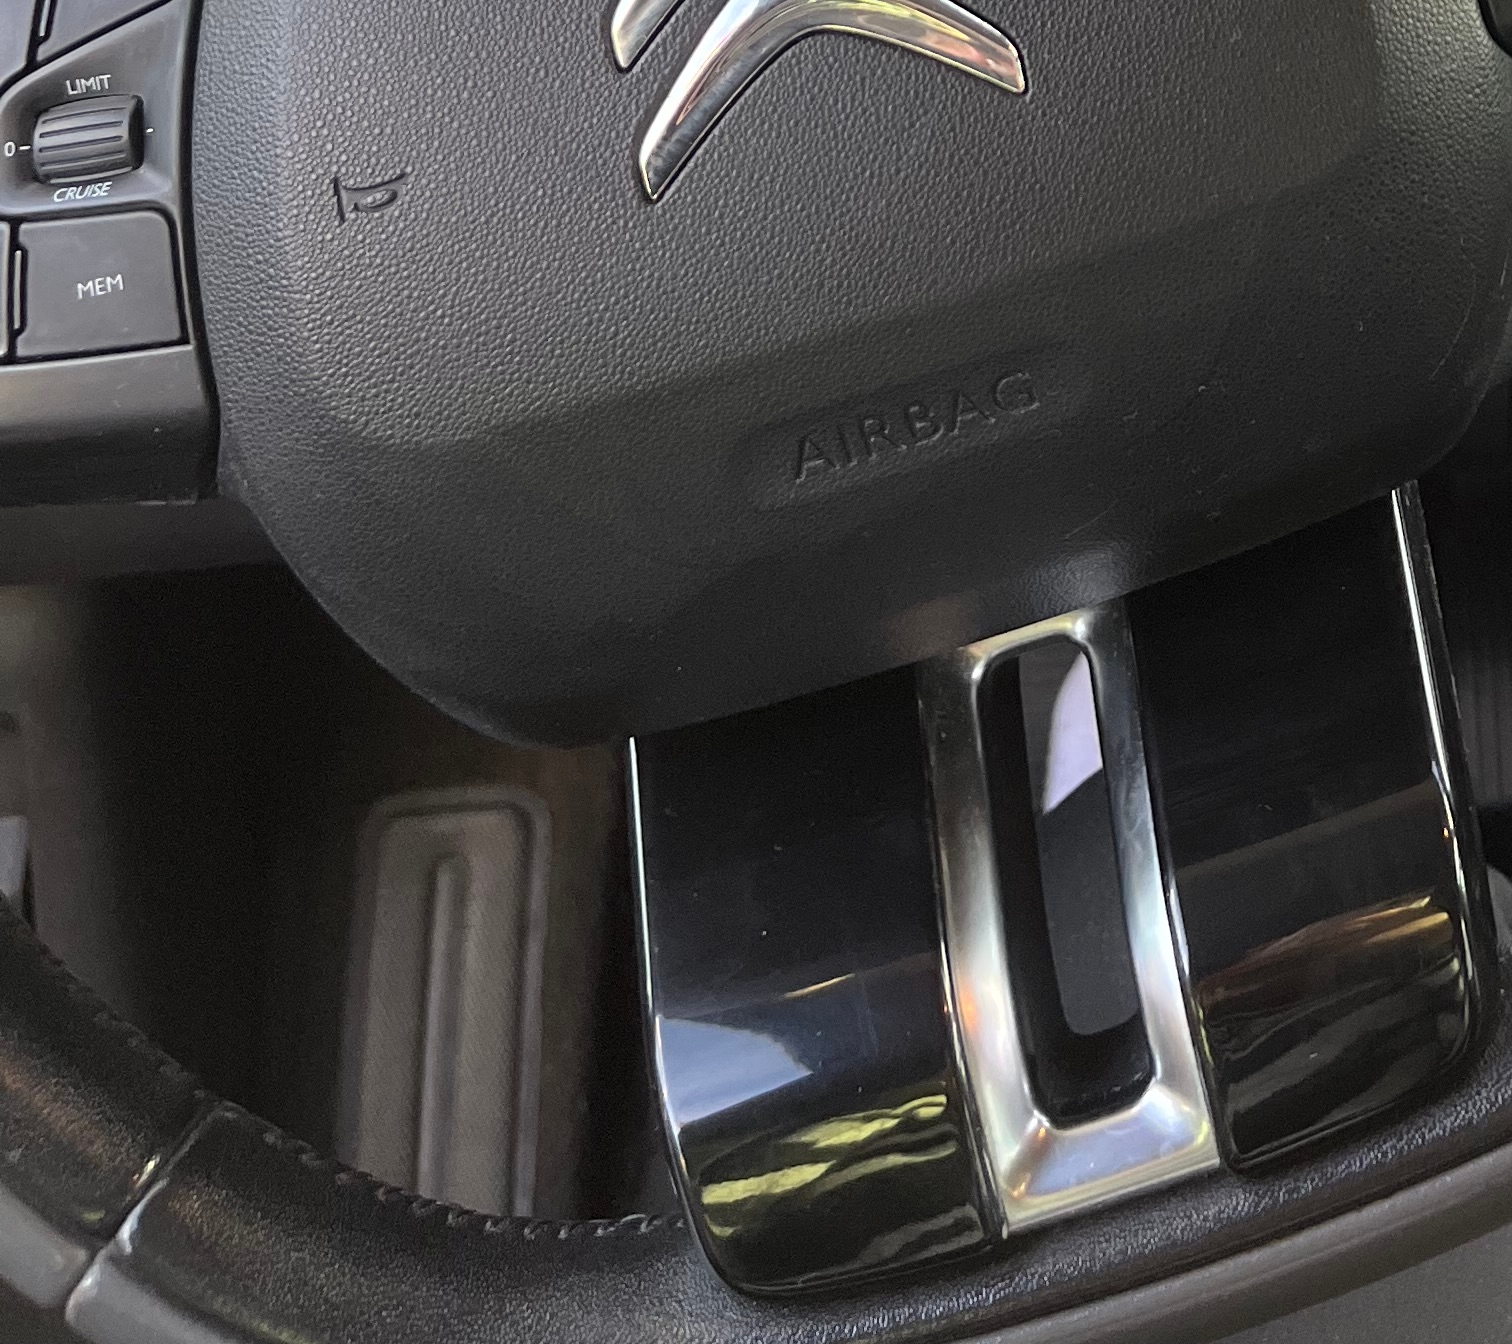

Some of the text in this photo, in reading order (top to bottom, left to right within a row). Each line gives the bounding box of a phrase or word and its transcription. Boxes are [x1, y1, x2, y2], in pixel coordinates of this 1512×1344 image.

[66, 74, 112, 95] LIMIT
[53, 180, 113, 203] CRUISE
[76, 273, 125, 300] MEM
[794, 370, 1042, 480] AIRBAG
